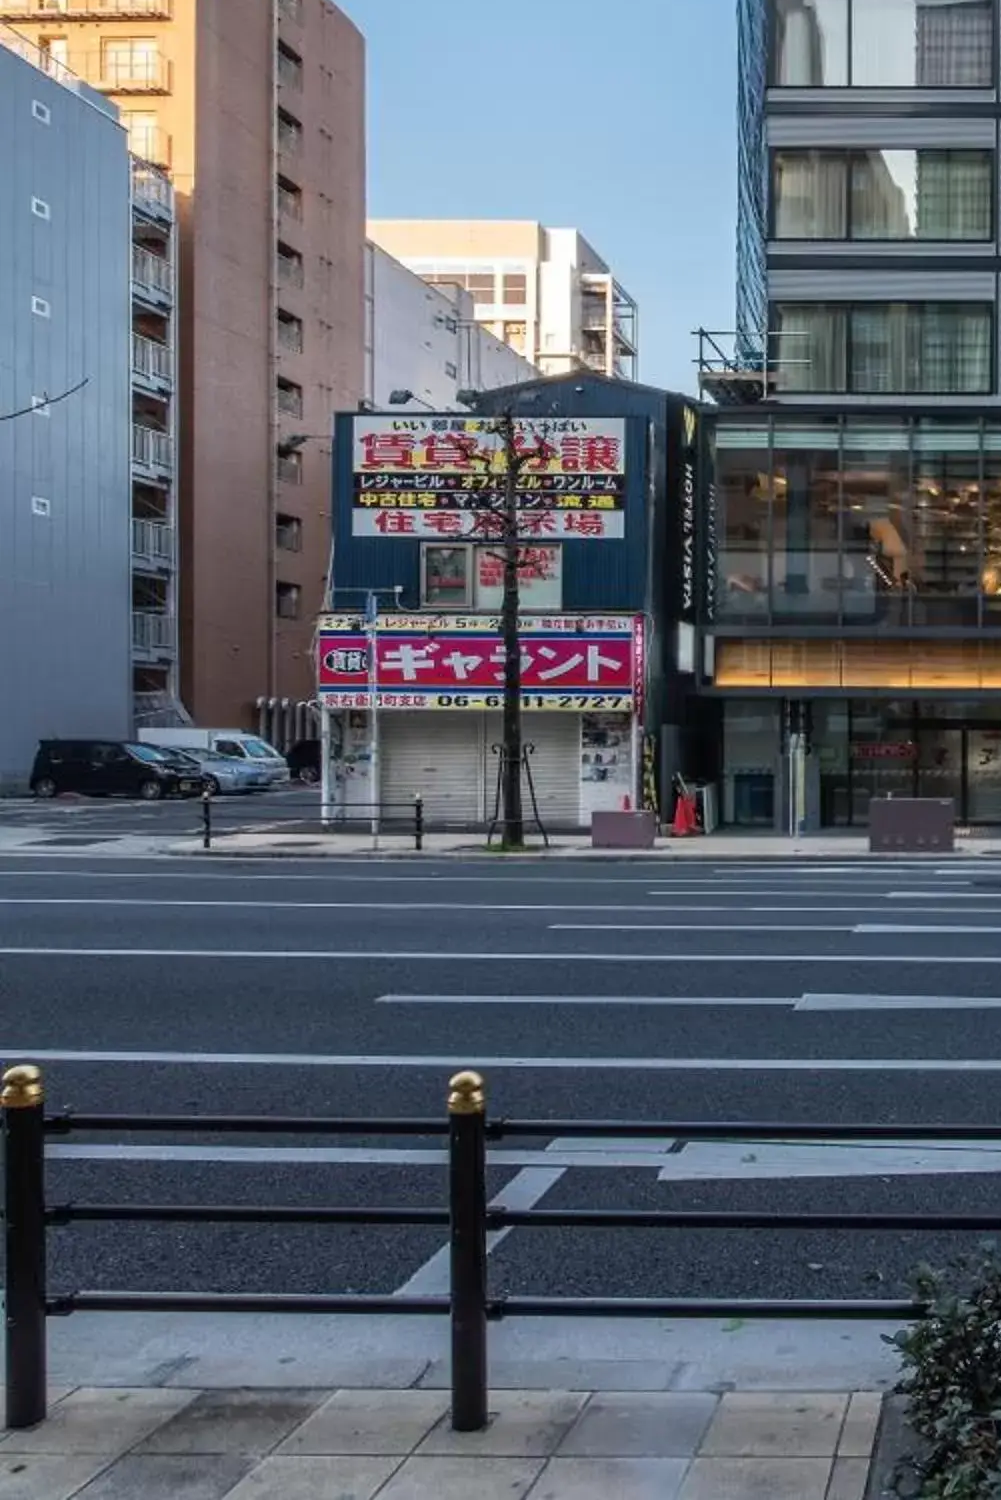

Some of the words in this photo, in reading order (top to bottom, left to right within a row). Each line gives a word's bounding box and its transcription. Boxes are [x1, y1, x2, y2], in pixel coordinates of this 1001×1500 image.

[361, 474, 444, 489] レジャービル
[553, 474, 617, 490] ワンルーム
[359, 492, 437, 507] 中古住宅
[683, 463, 694, 532] HOTEL
[683, 535, 693, 609] VISTA
[437, 693, 622, 708] 06-611-2727
